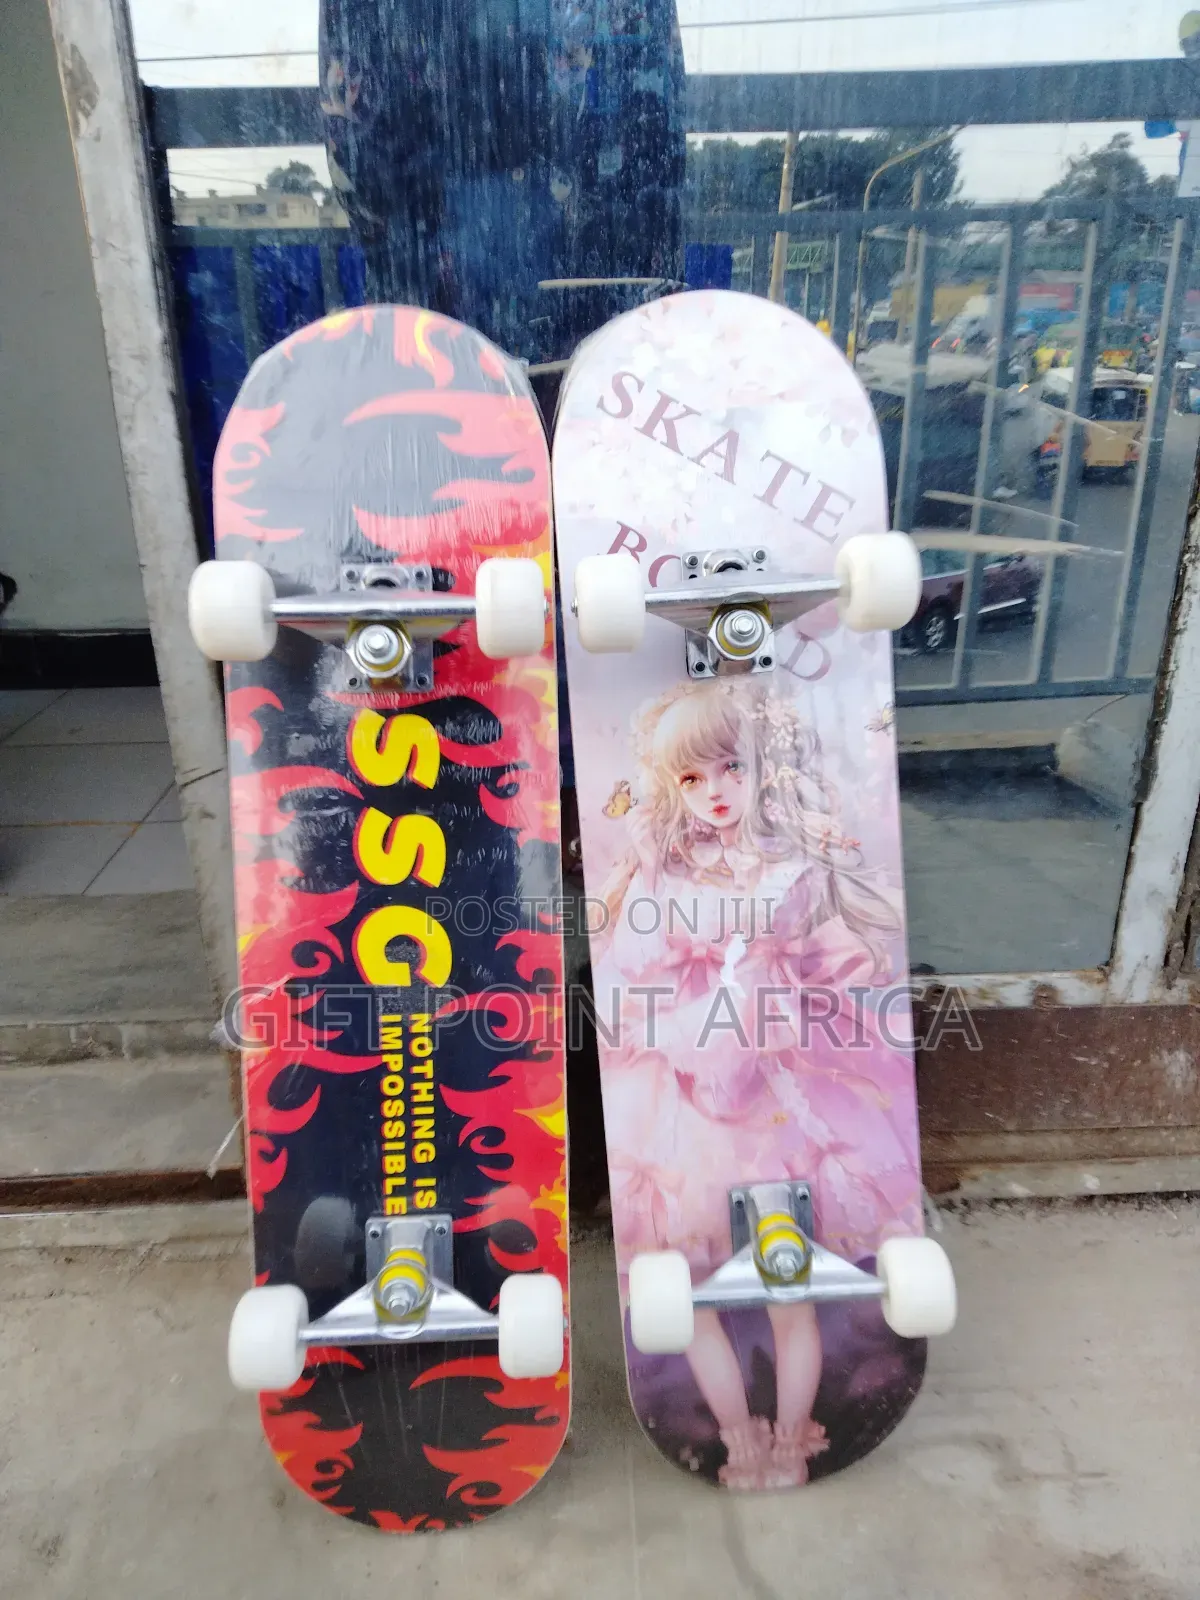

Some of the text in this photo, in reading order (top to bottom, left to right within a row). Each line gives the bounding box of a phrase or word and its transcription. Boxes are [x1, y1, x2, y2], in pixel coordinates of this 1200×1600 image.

[595, 370, 856, 545] SKATE
[347, 708, 453, 988] SSG
[378, 1013, 408, 1217] IMPOSSIBLE
[408, 1012, 438, 1210] NOTHING IS
